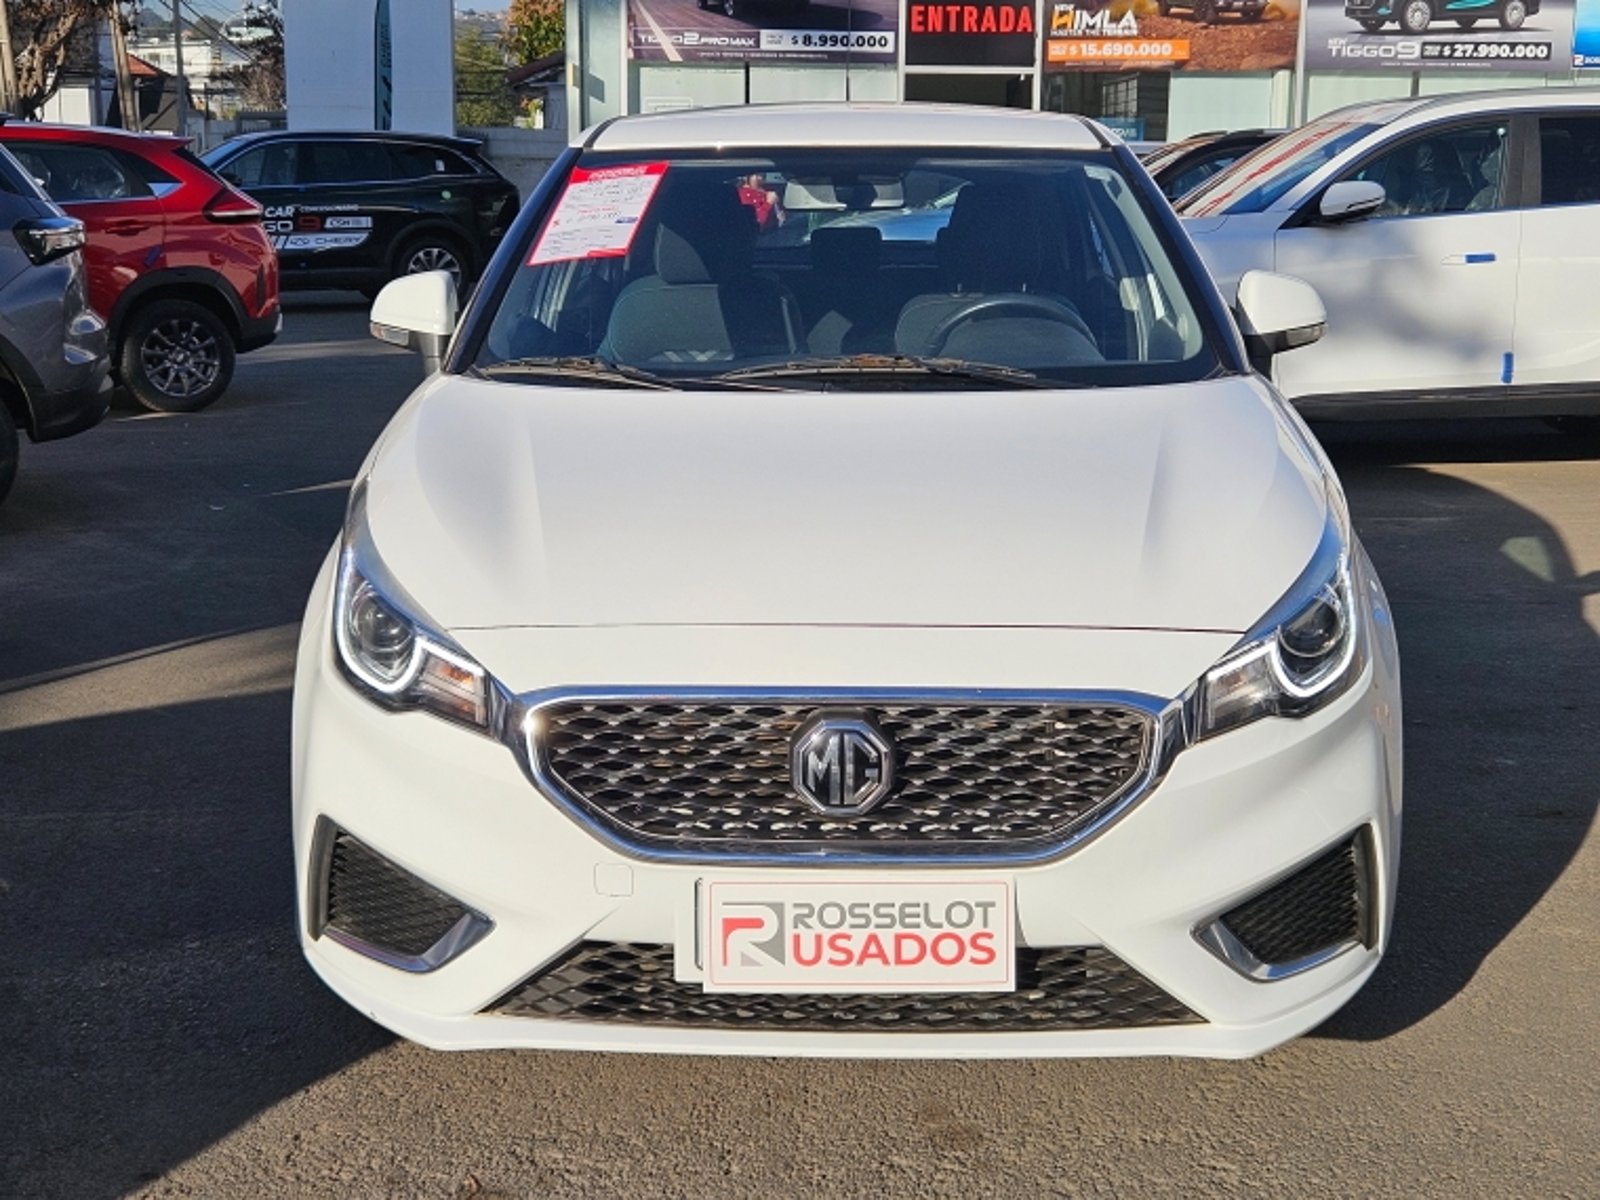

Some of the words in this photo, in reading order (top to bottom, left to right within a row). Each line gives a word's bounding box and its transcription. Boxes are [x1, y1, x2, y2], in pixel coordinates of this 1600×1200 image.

[911, 5, 1033, 33] ENTRADA
[1051, 9, 1138, 30] HIMLA
[802, 34, 888, 48] 8.990.000
[1080, 43, 1172, 56] 15.690.000
[1453, 44, 1549, 58] 27.990.000
[806, 731, 882, 805] MG
[792, 901, 996, 930] ROSSELOT
[792, 932, 997, 967] USADOS
